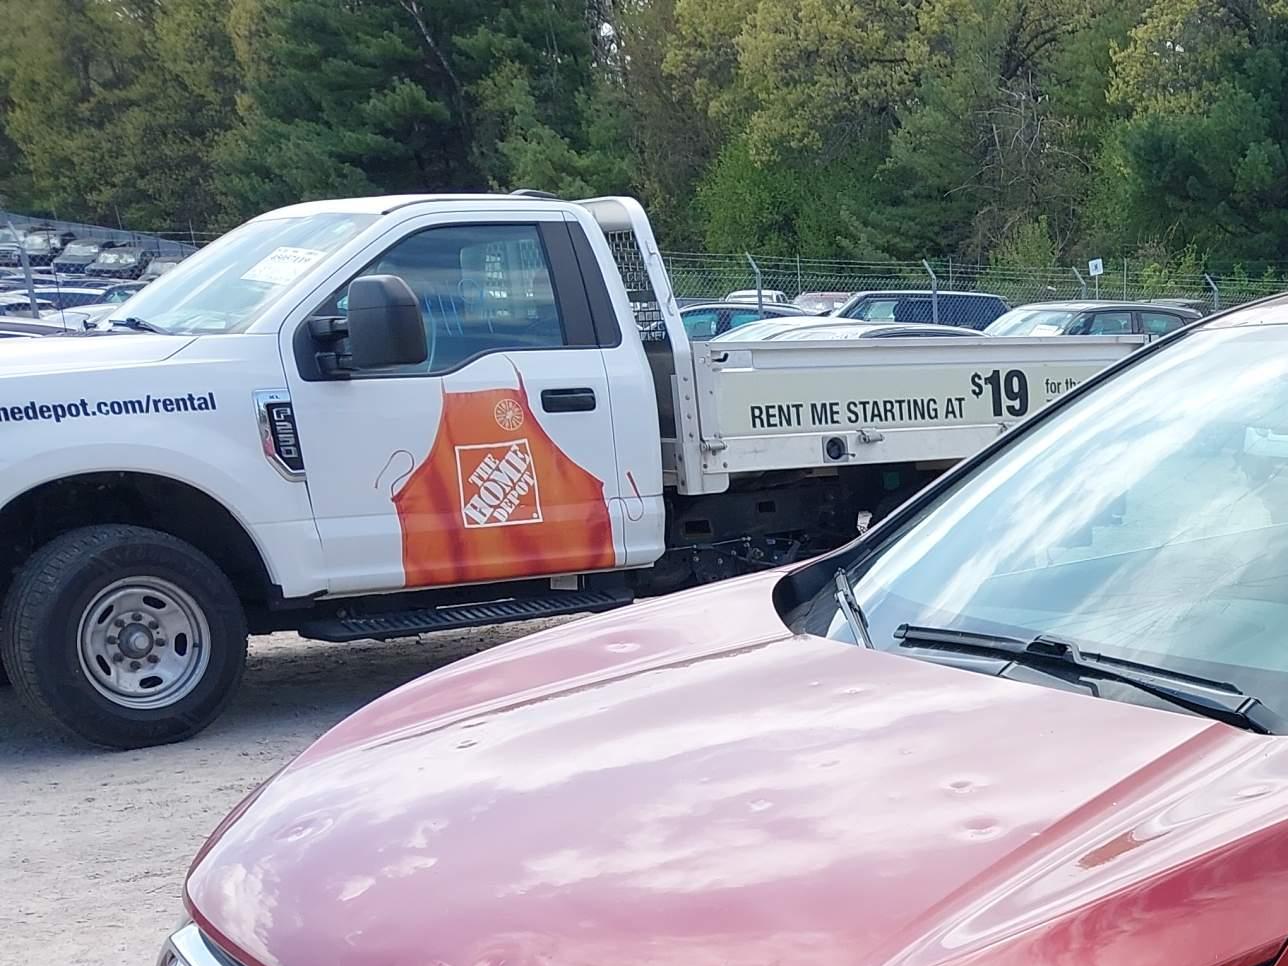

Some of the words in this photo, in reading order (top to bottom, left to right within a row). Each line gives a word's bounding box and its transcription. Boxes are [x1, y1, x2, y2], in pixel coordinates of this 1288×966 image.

[750, 403, 803, 429] RENT
[811, 402, 841, 426] ME
[847, 398, 938, 424] STARTING
[944, 397, 966, 420] AT
[970, 369, 1029, 418] $19
[1045, 377, 1062, 394] for
[1065, 377, 1081, 392] th
[463, 444, 531, 525] HOME
[467, 453, 500, 487] THE
[493, 471, 534, 522] DEPOT
